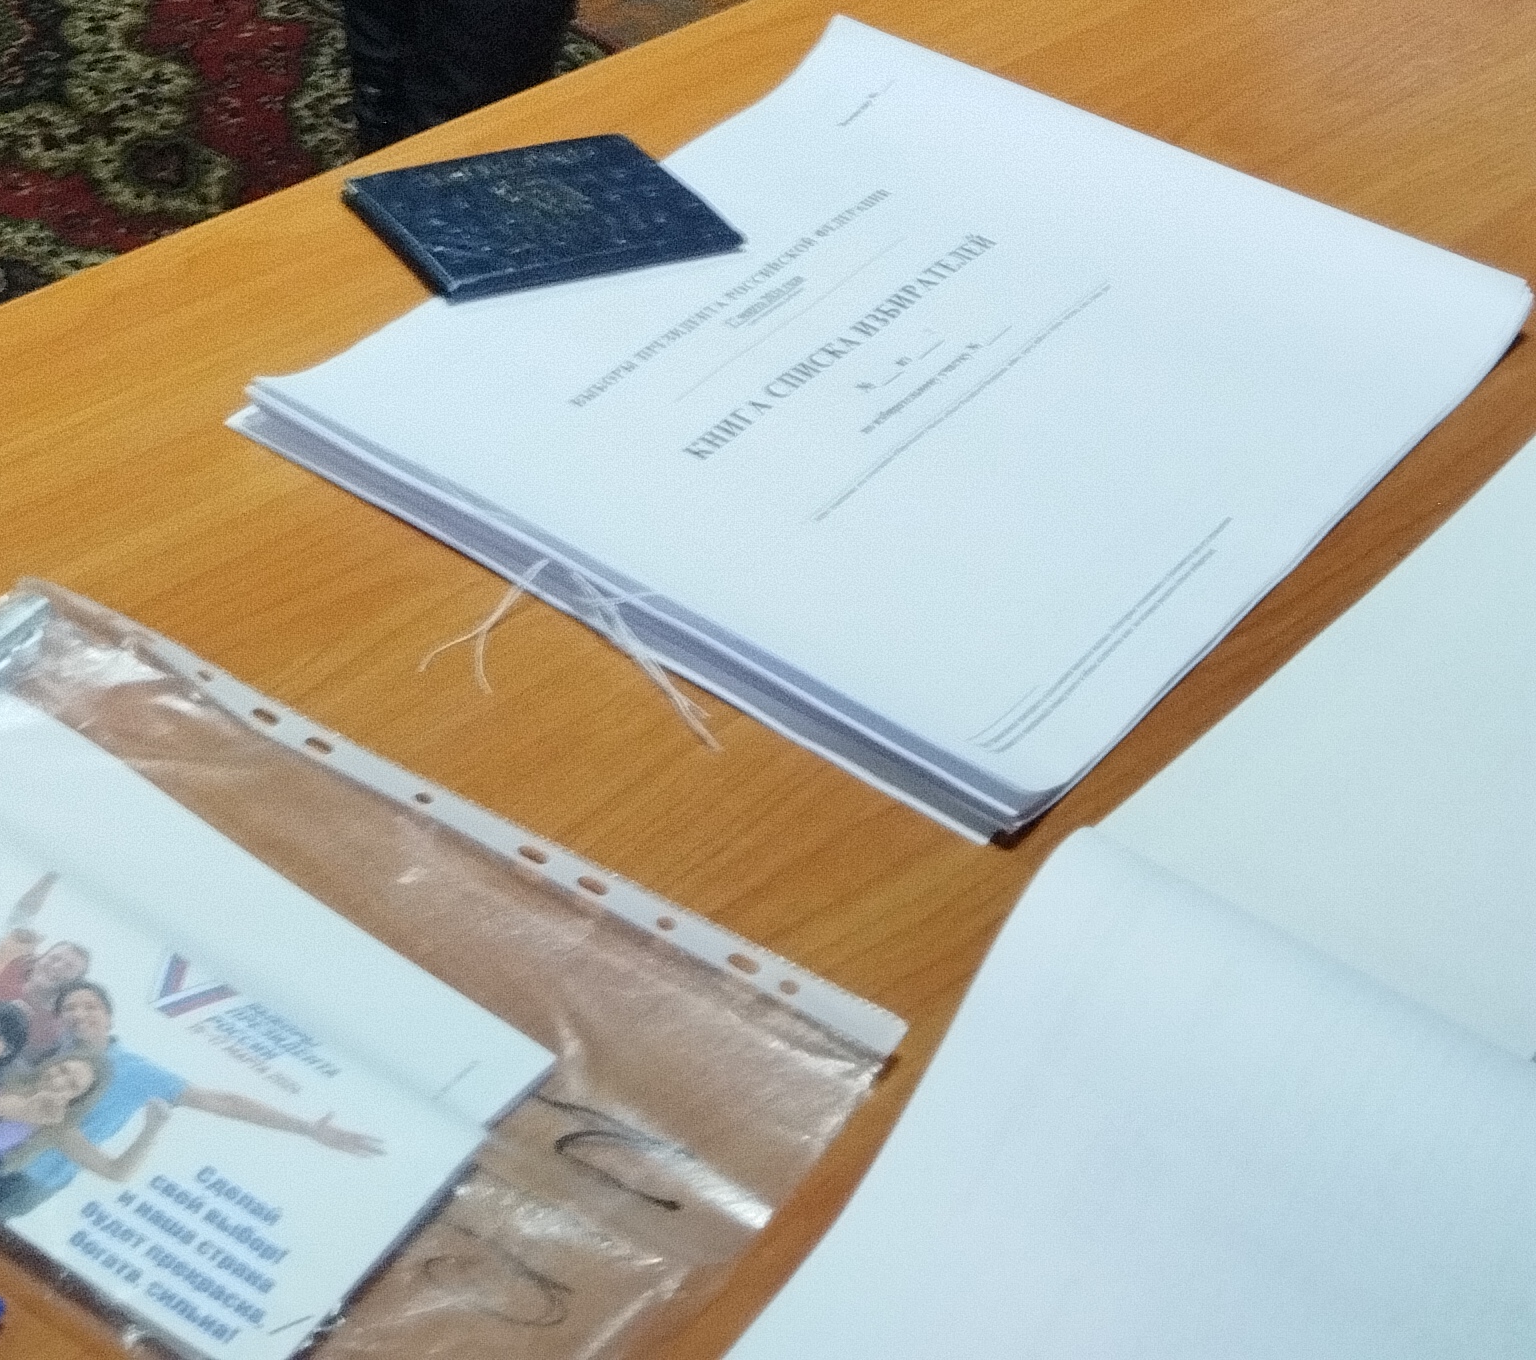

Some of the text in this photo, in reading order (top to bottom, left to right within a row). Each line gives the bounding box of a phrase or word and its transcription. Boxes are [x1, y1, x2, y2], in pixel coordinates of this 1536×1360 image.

[725, 237, 818, 301] РОССИЙСКОЙ
[683, 400, 773, 460] КНИГА
[765, 336, 861, 398] СПИСКА
[850, 233, 997, 338] ИЗБИРАТЕЛЕЙ
[80, 1200, 147, 1250] будет
[149, 1174, 290, 1265] свой выбор!
[196, 1165, 283, 1226] Сделай
[117, 1190, 276, 1294] и наша страна
